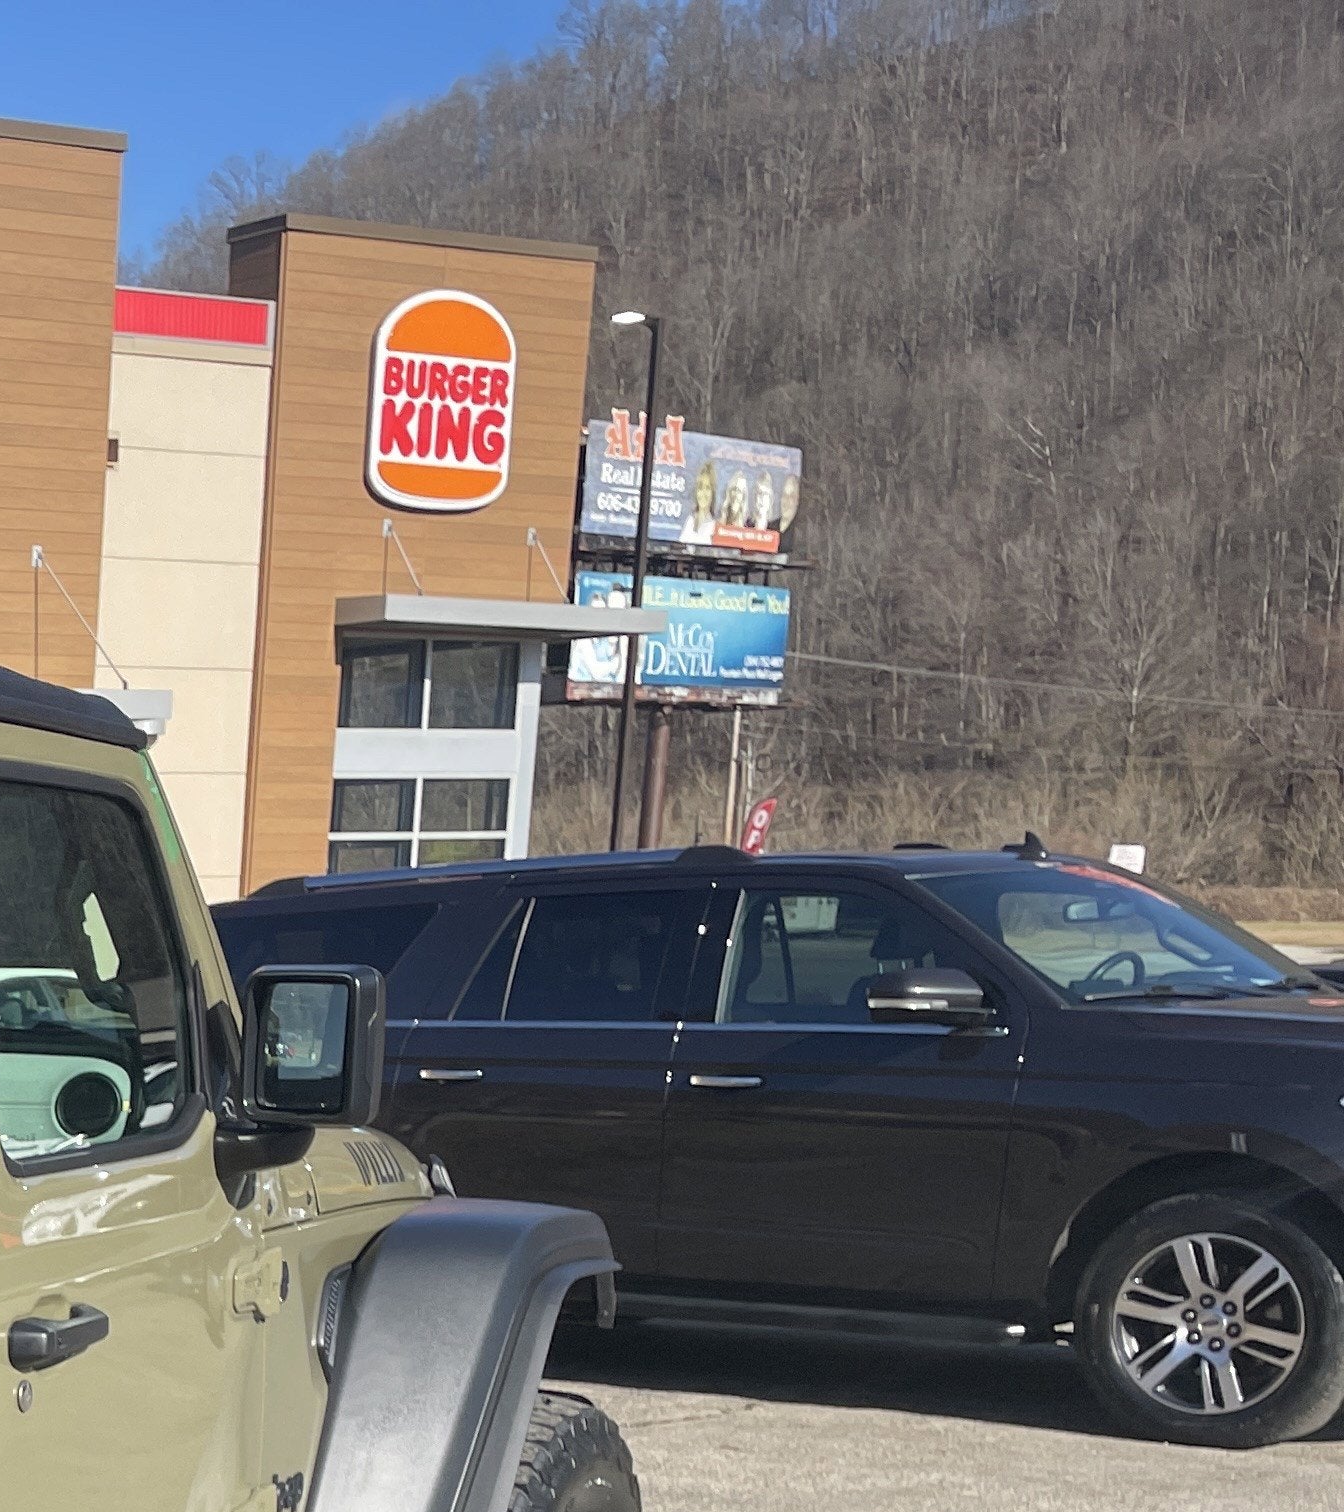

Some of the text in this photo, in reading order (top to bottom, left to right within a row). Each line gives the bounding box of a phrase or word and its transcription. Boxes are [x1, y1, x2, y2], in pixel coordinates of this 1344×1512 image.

[383, 357, 509, 408] BURGER
[380, 399, 506, 464] KING
[636, 466, 686, 492] tate
[714, 588, 747, 612] Good
